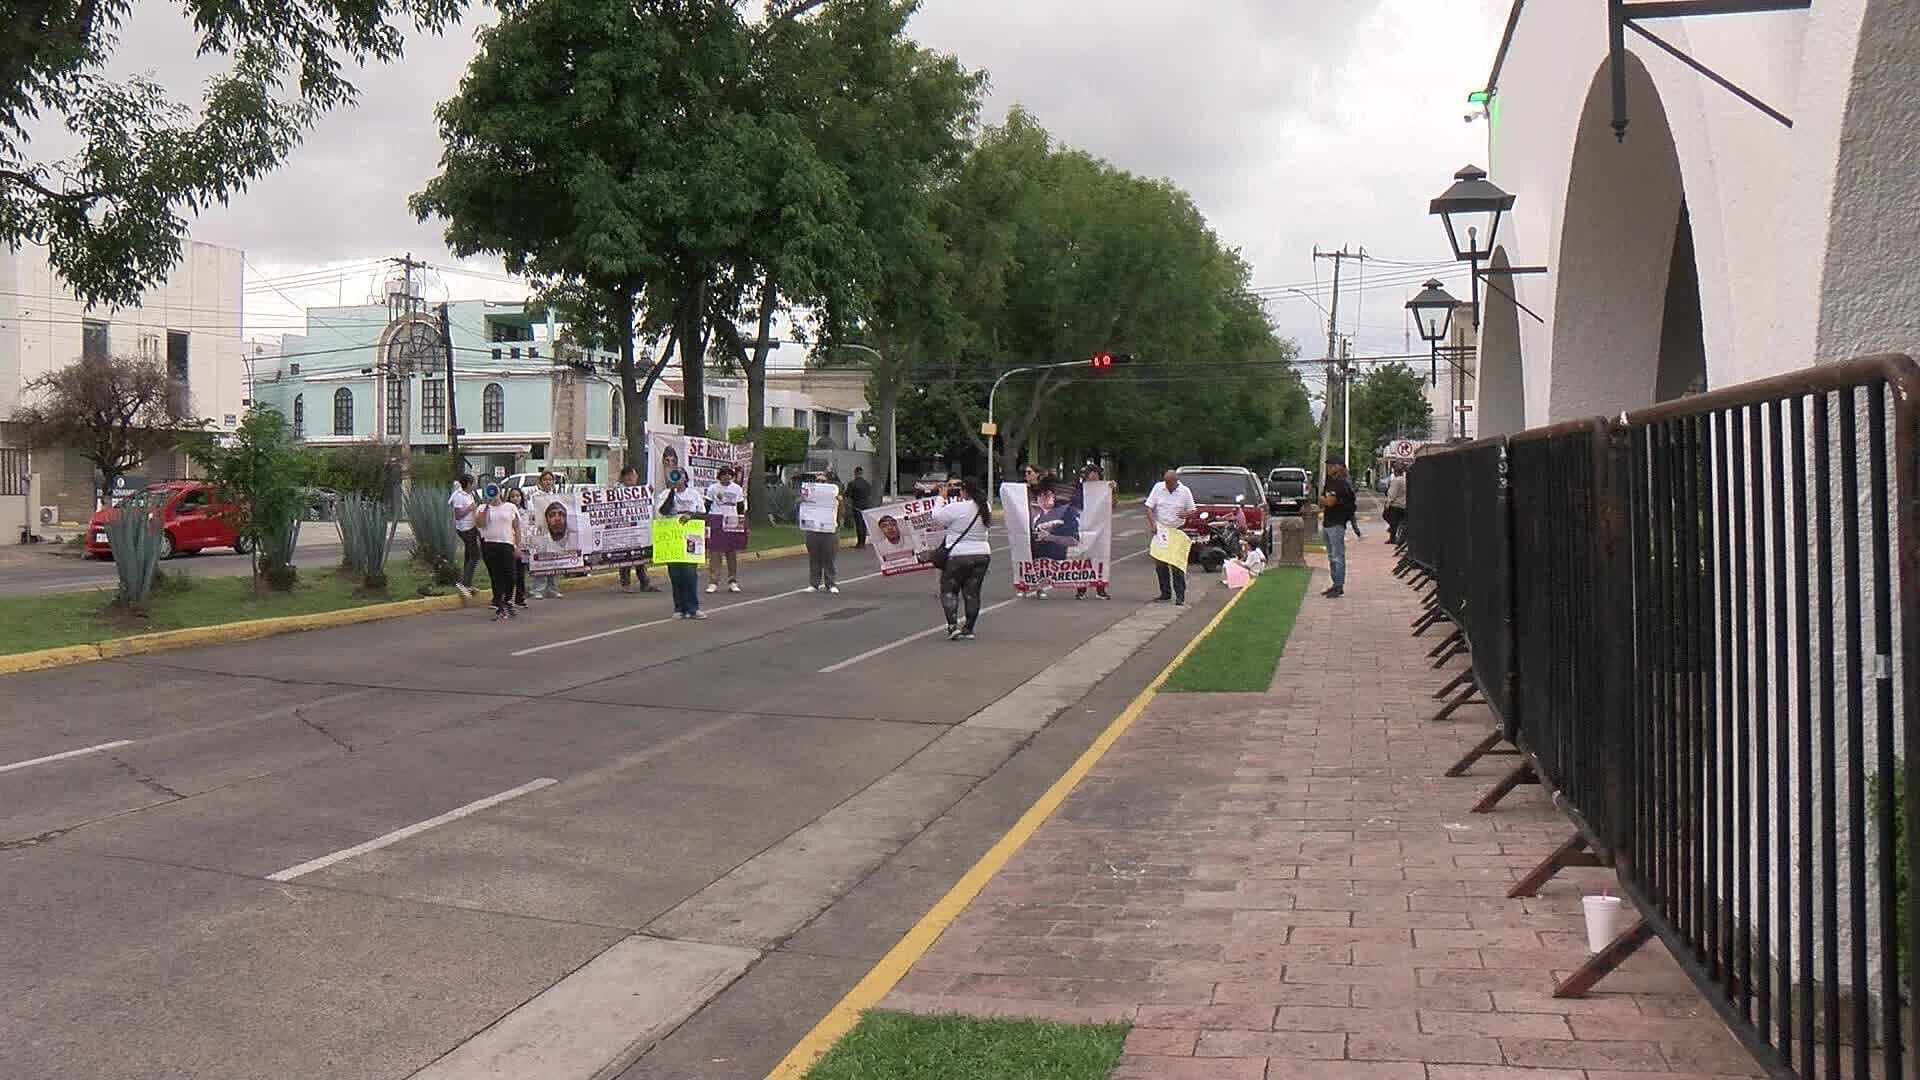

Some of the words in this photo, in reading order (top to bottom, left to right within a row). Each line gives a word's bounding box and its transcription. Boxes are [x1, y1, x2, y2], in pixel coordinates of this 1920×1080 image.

[689, 439, 704, 456] SE
[582, 490, 602, 504] SE
[606, 486, 649, 501] BUSCA
[904, 501, 920, 514] SE
